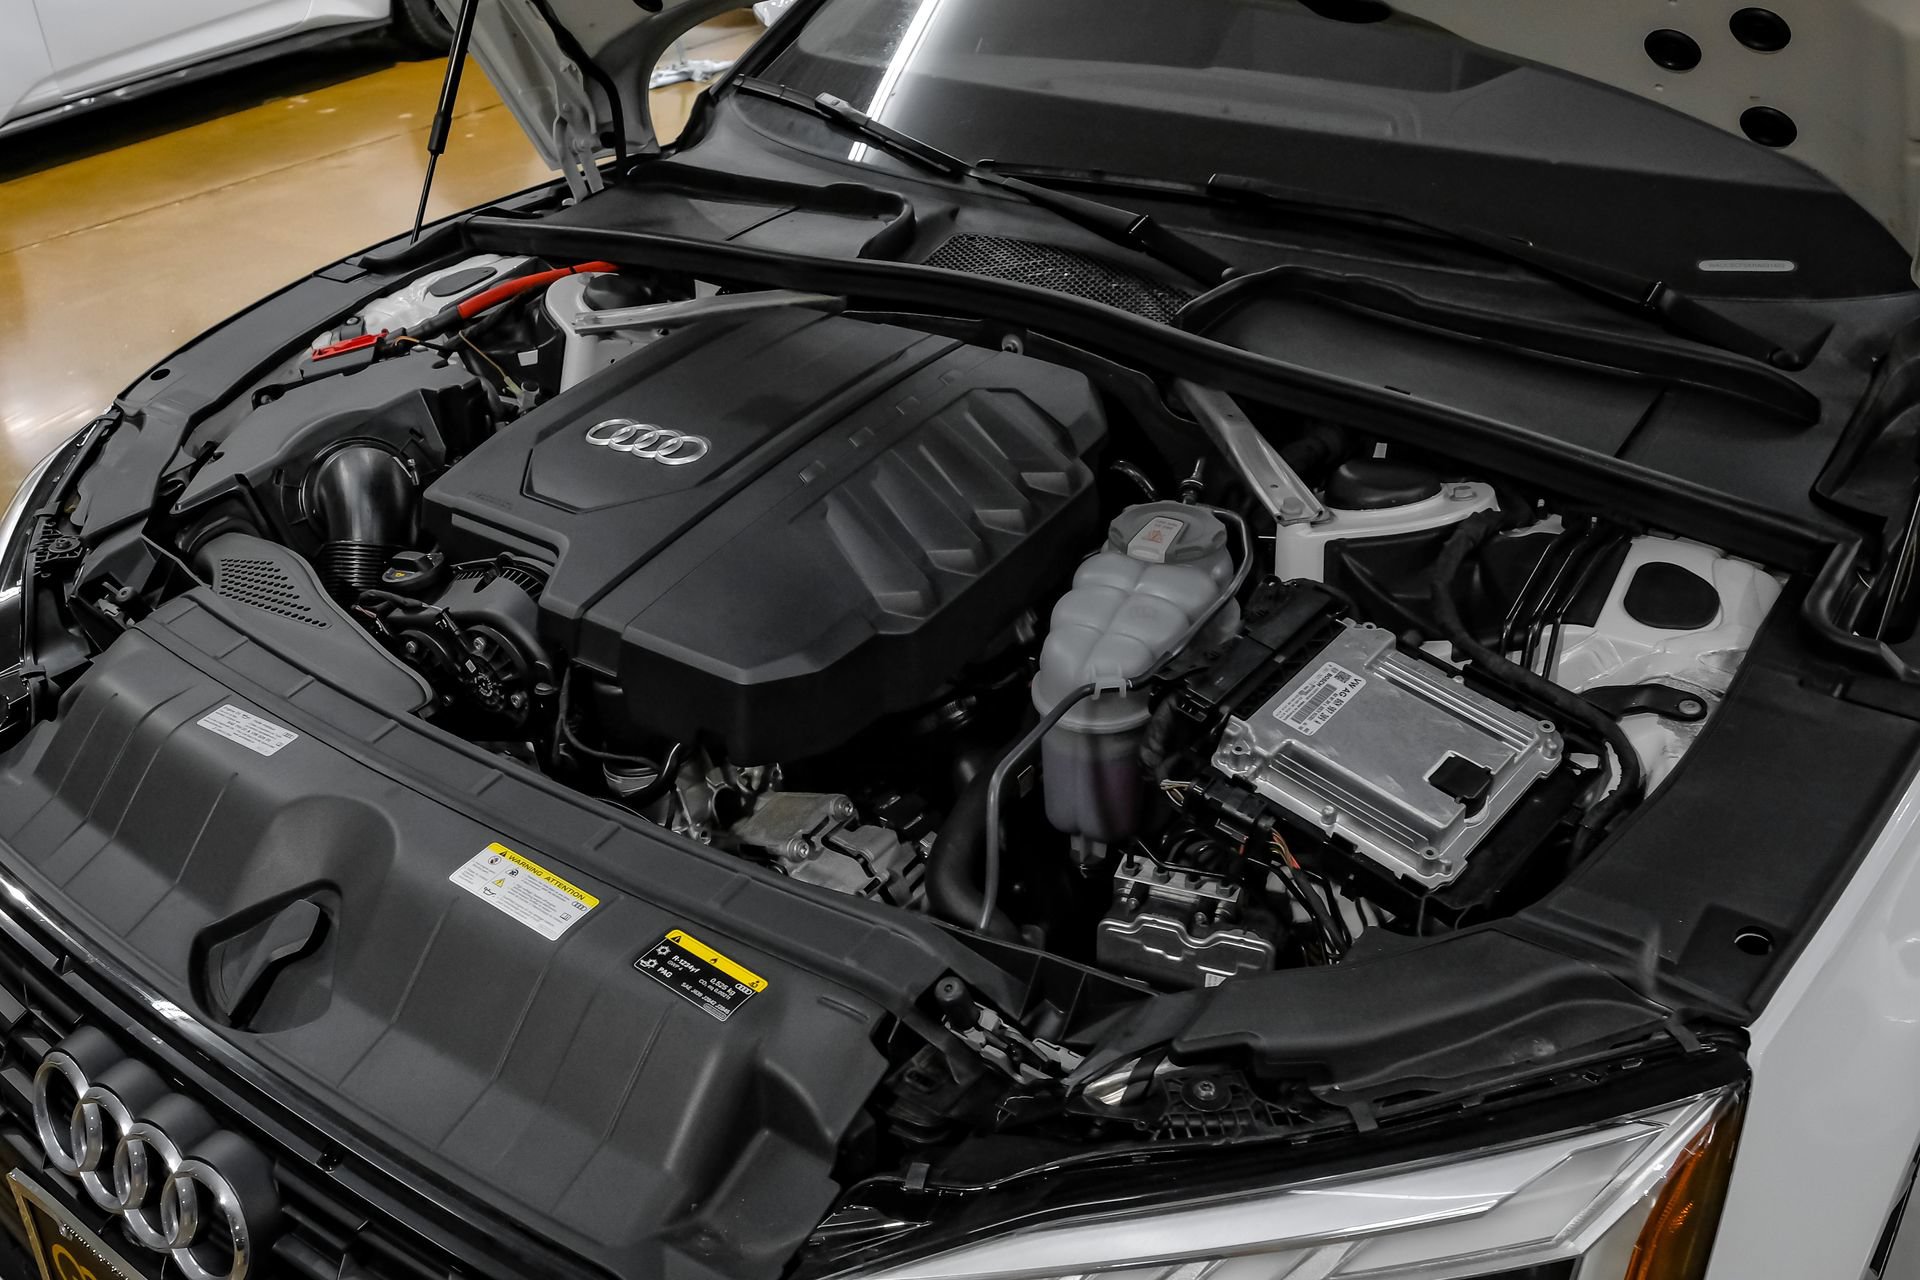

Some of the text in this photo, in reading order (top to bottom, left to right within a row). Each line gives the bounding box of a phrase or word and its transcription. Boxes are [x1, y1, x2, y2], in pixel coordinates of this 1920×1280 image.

[1316, 672, 1333, 687] BOSCH
[1348, 678, 1361, 689] VW
[1339, 687, 1351, 698] AG
[508, 854, 544, 877] WARNING
[544, 876, 586, 901] ATTENTION
[671, 955, 700, 974] R-1234yf
[657, 966, 673, 978] PAG
[681, 982, 692, 991] SAE
[726, 987, 736, 997] kg
